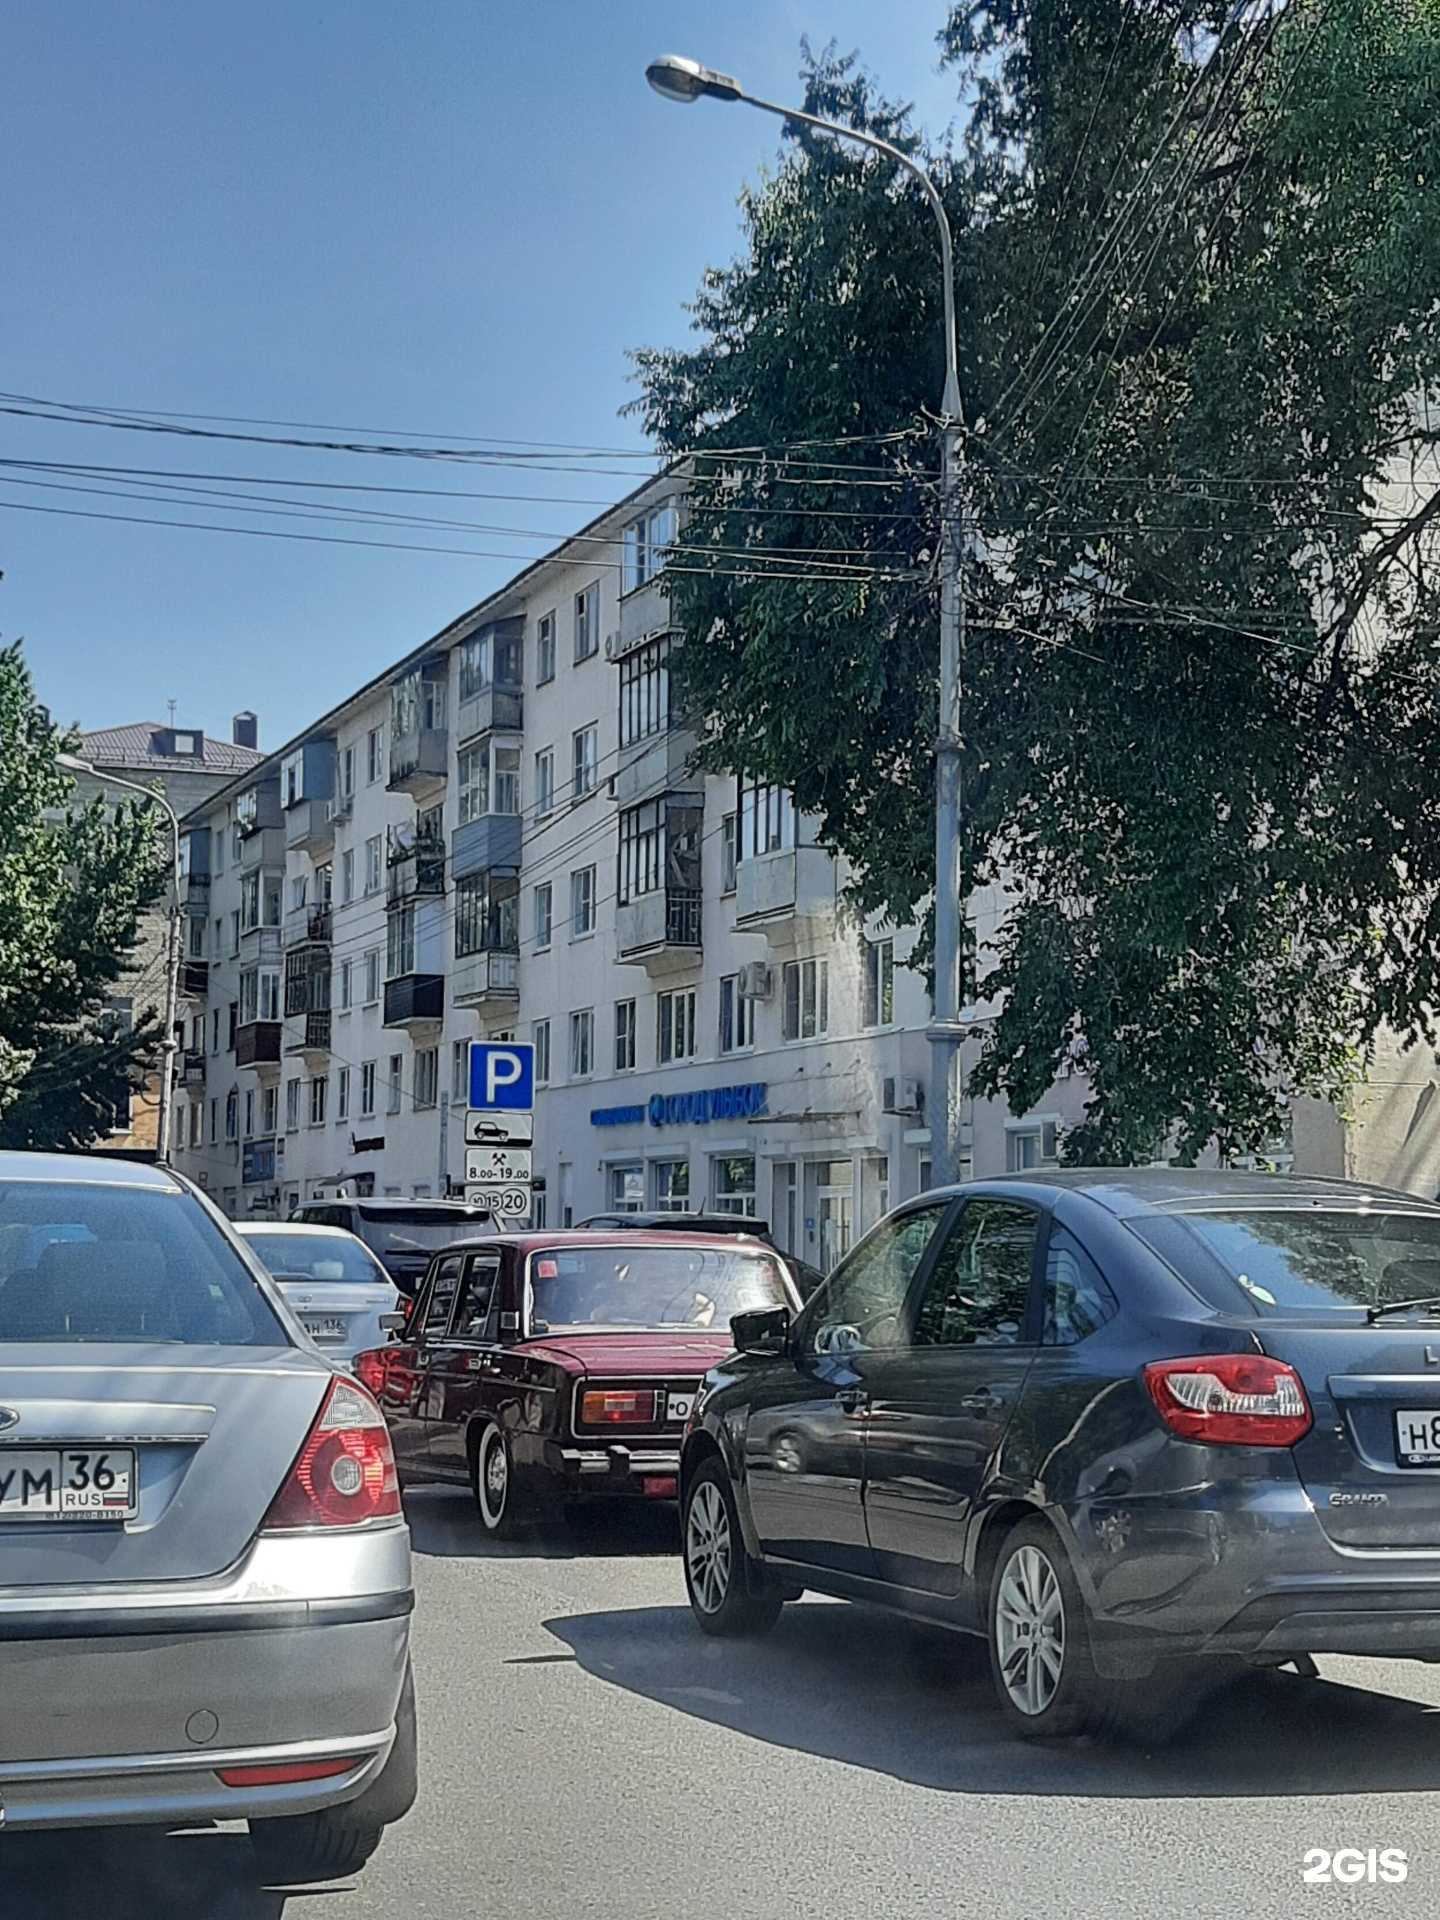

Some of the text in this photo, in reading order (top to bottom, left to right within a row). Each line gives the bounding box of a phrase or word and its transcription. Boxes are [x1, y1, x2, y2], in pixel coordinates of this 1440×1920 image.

[486, 1051, 522, 1103] P
[488, 1195, 500, 1208] 15
[504, 1194, 523, 1209] 20
[68, 1454, 116, 1490] 36
[65, 1493, 101, 1506] RUS
